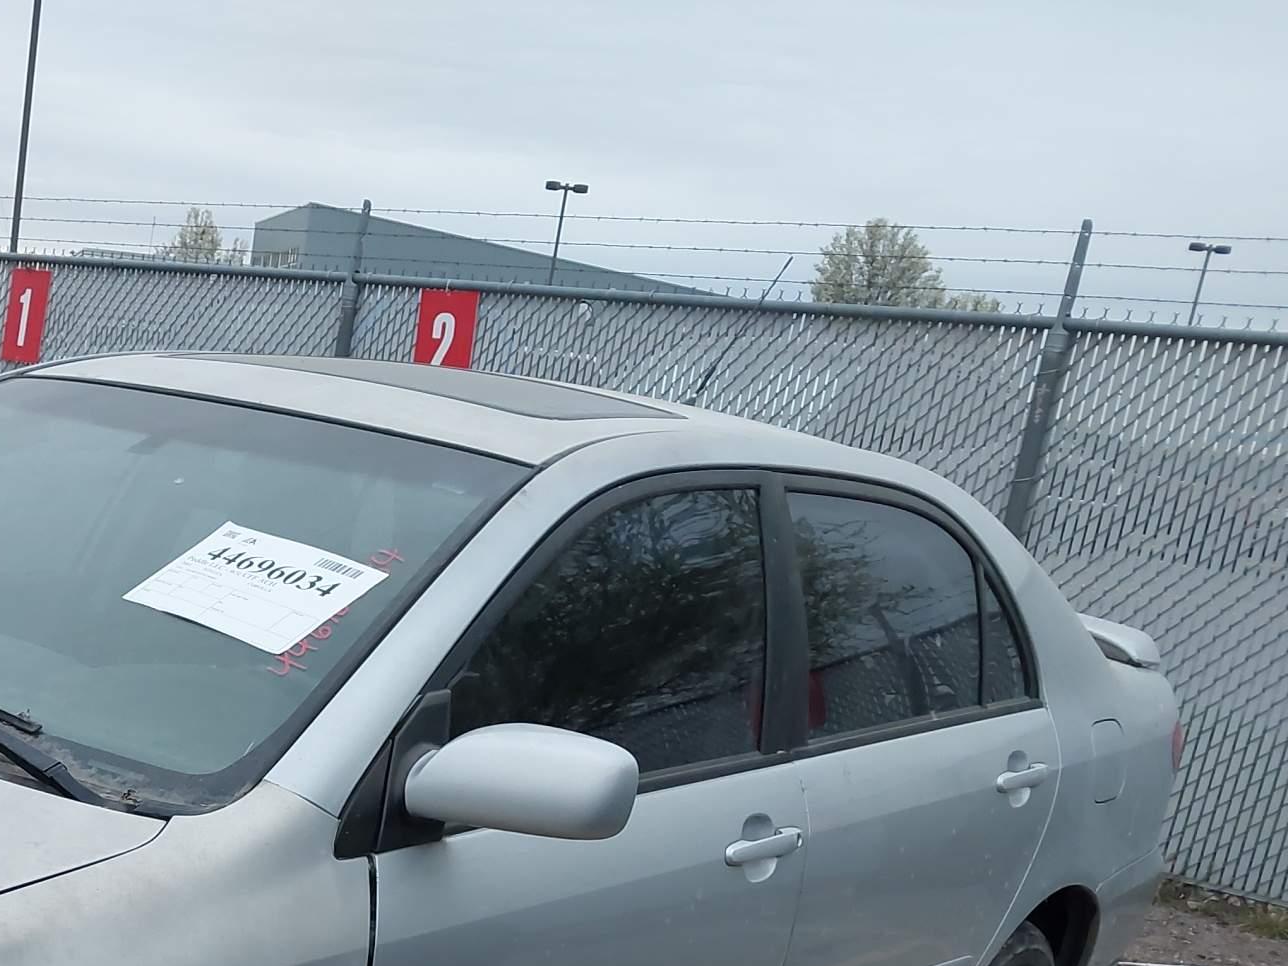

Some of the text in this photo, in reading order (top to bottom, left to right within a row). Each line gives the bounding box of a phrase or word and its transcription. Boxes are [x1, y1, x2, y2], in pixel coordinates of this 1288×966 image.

[17, 288, 32, 347] 1
[430, 312, 456, 366] 2
[207, 546, 342, 597] 44696034
